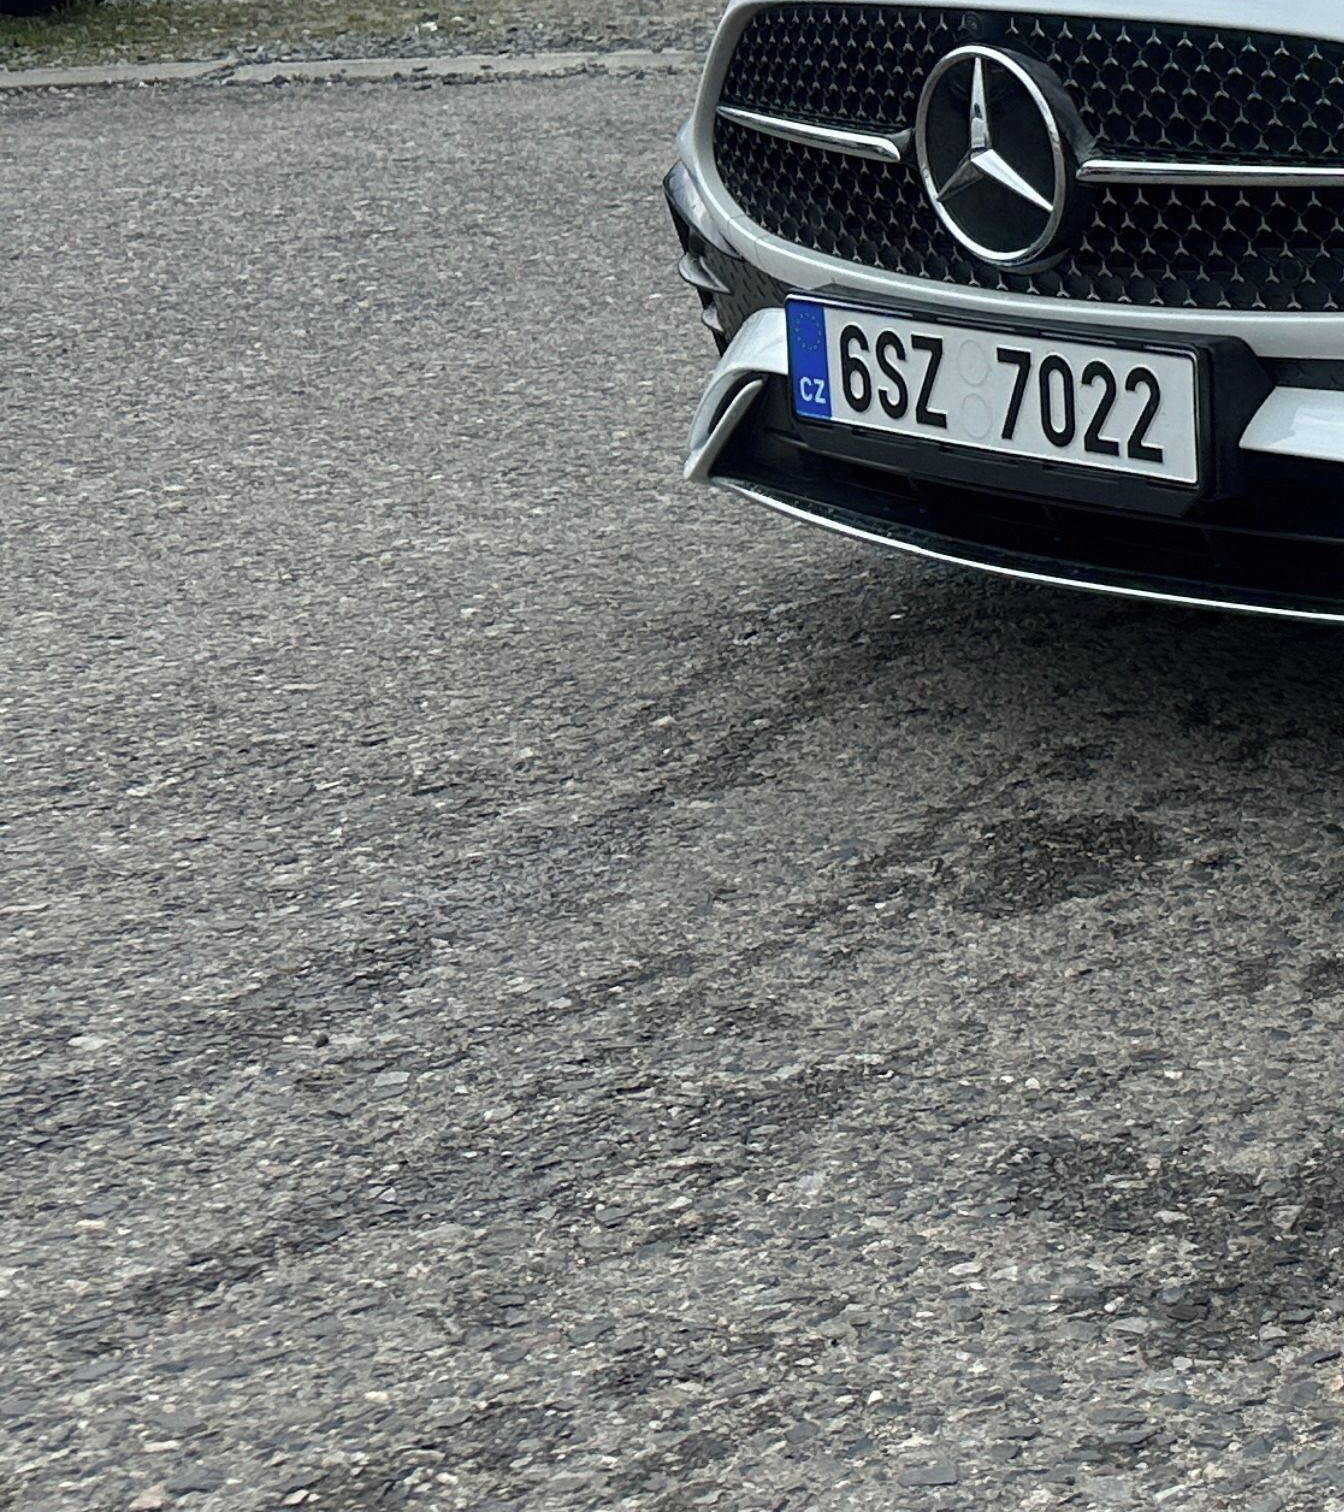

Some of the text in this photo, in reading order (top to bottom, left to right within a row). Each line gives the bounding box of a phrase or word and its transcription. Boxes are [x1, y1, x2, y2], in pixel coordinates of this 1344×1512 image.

[799, 376, 826, 404] CZ
[839, 324, 1164, 464] 6SZ 7022
